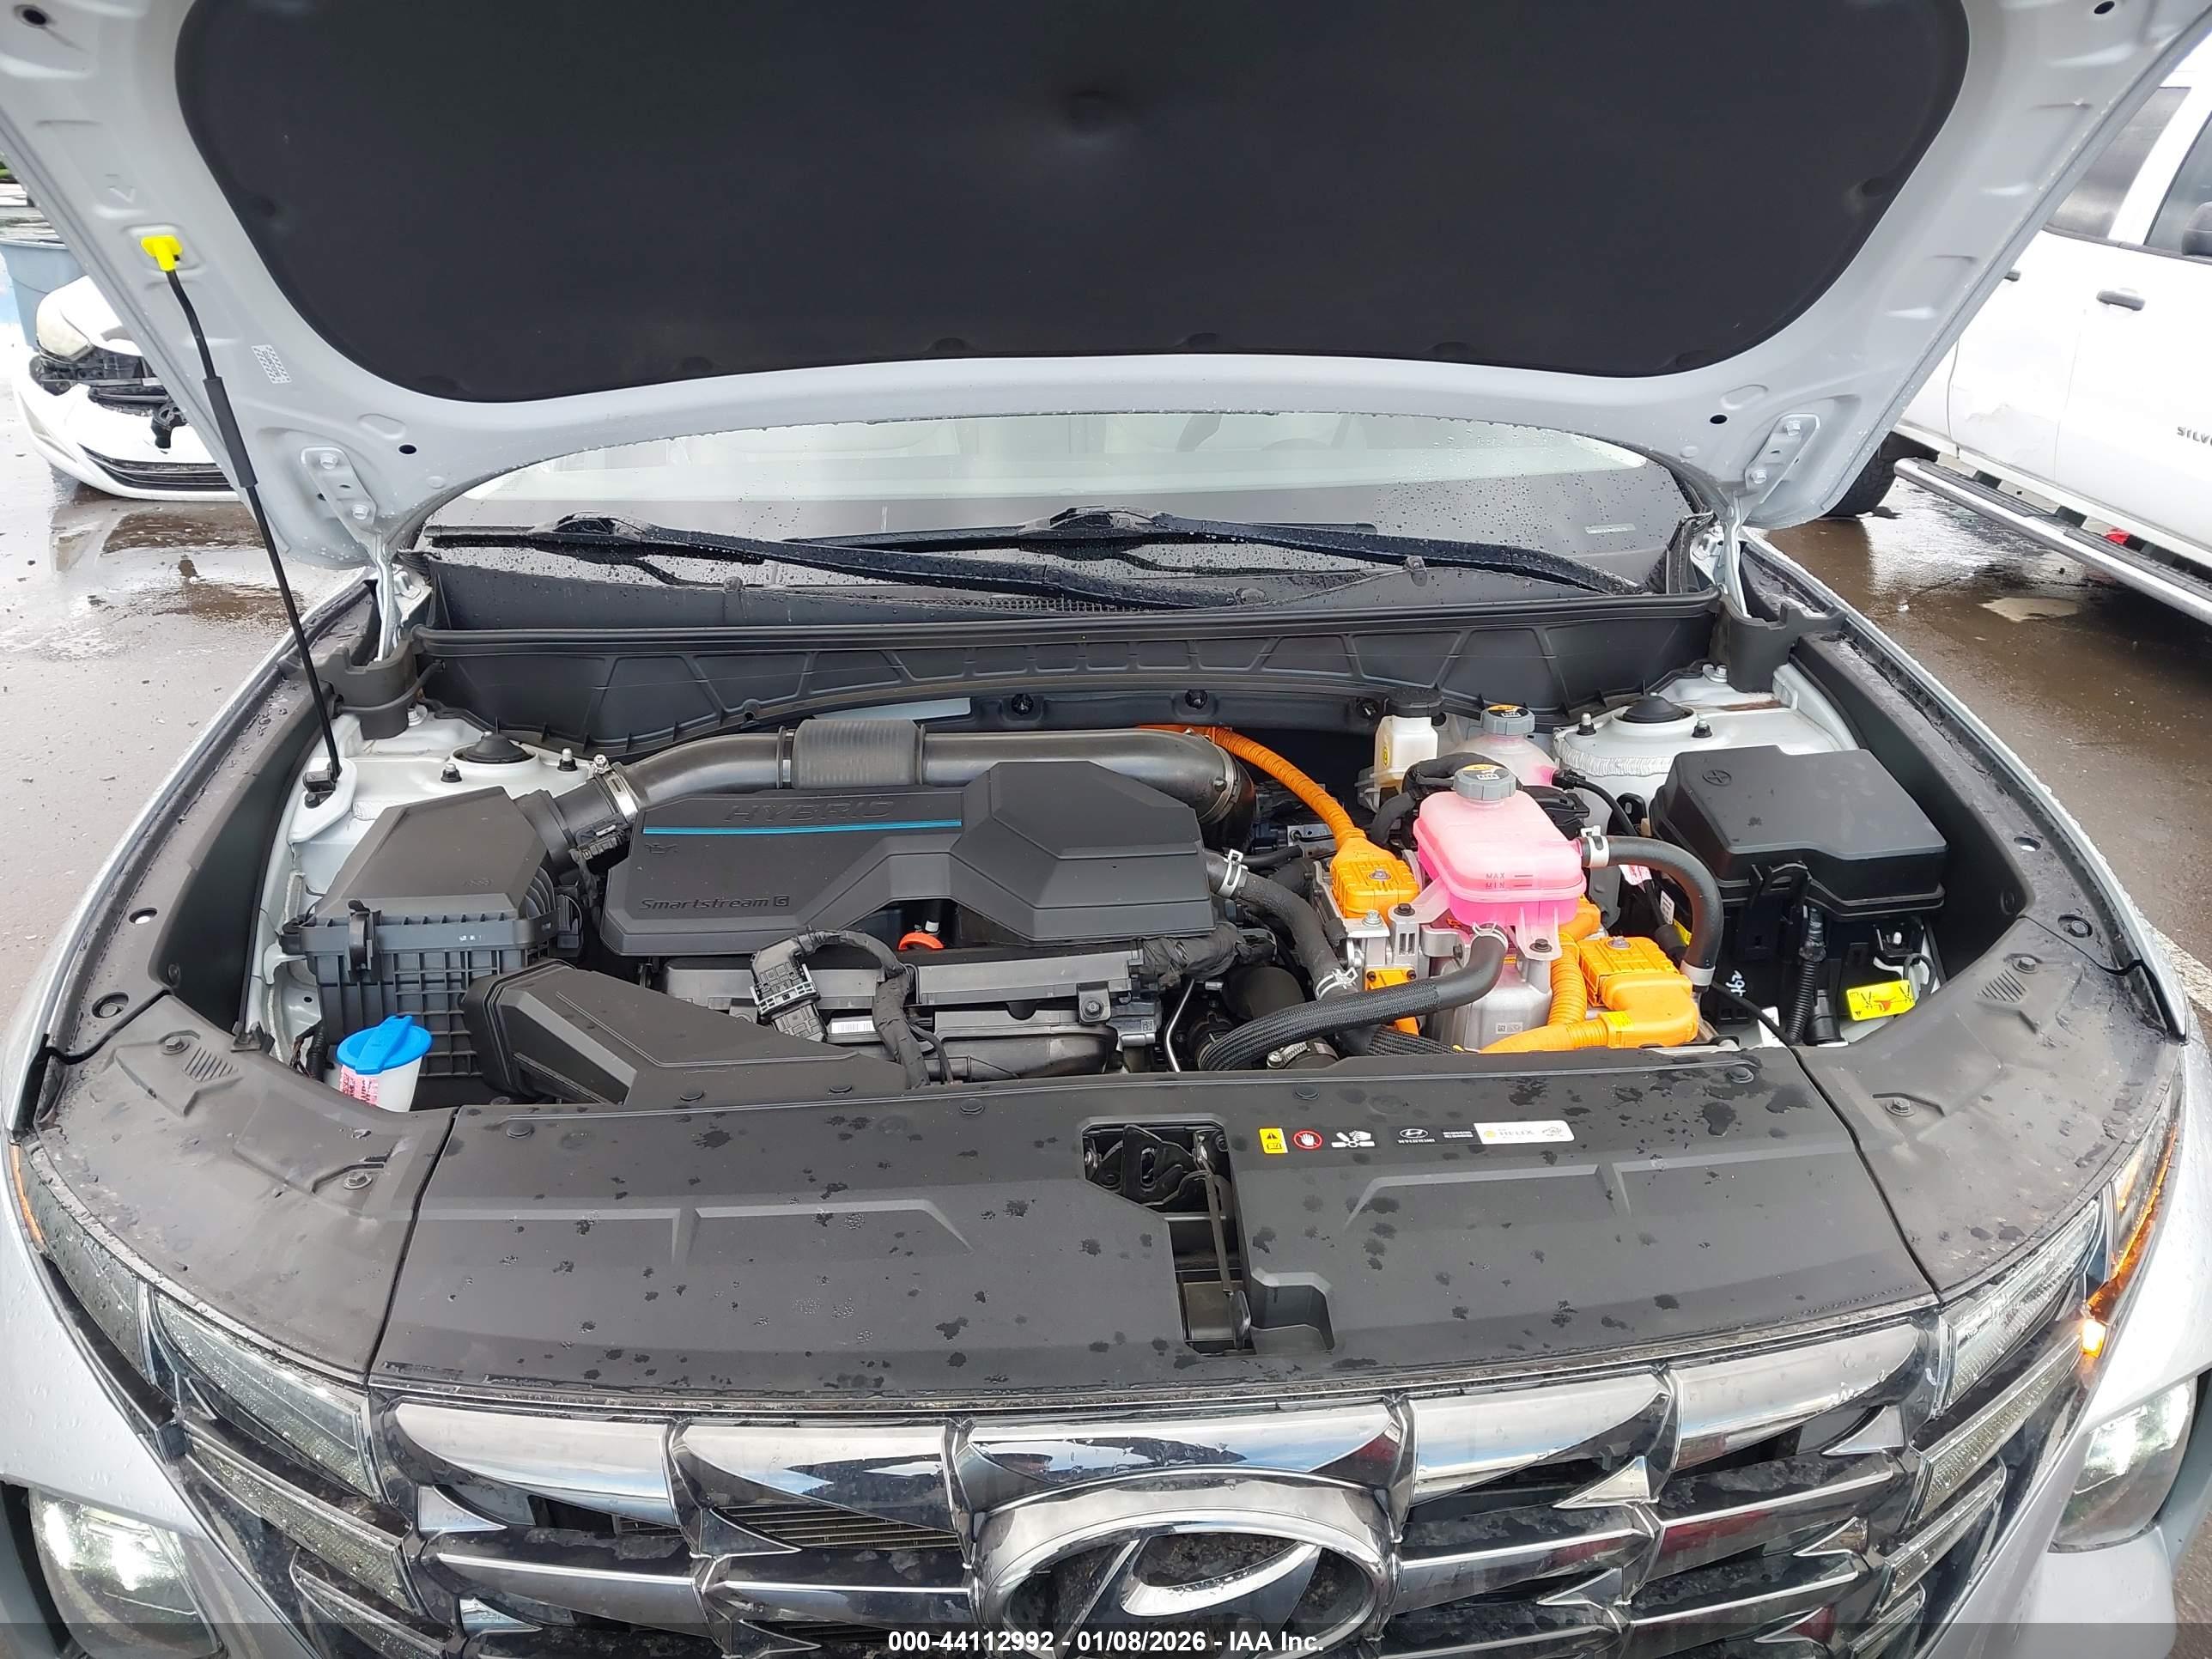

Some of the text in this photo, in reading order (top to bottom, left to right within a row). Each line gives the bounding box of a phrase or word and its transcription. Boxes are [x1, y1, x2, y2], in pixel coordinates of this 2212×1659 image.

[2177, 426, 2212, 447] SILV
[724, 800, 894, 822] HYBRID
[640, 897, 769, 909] Smartstream
